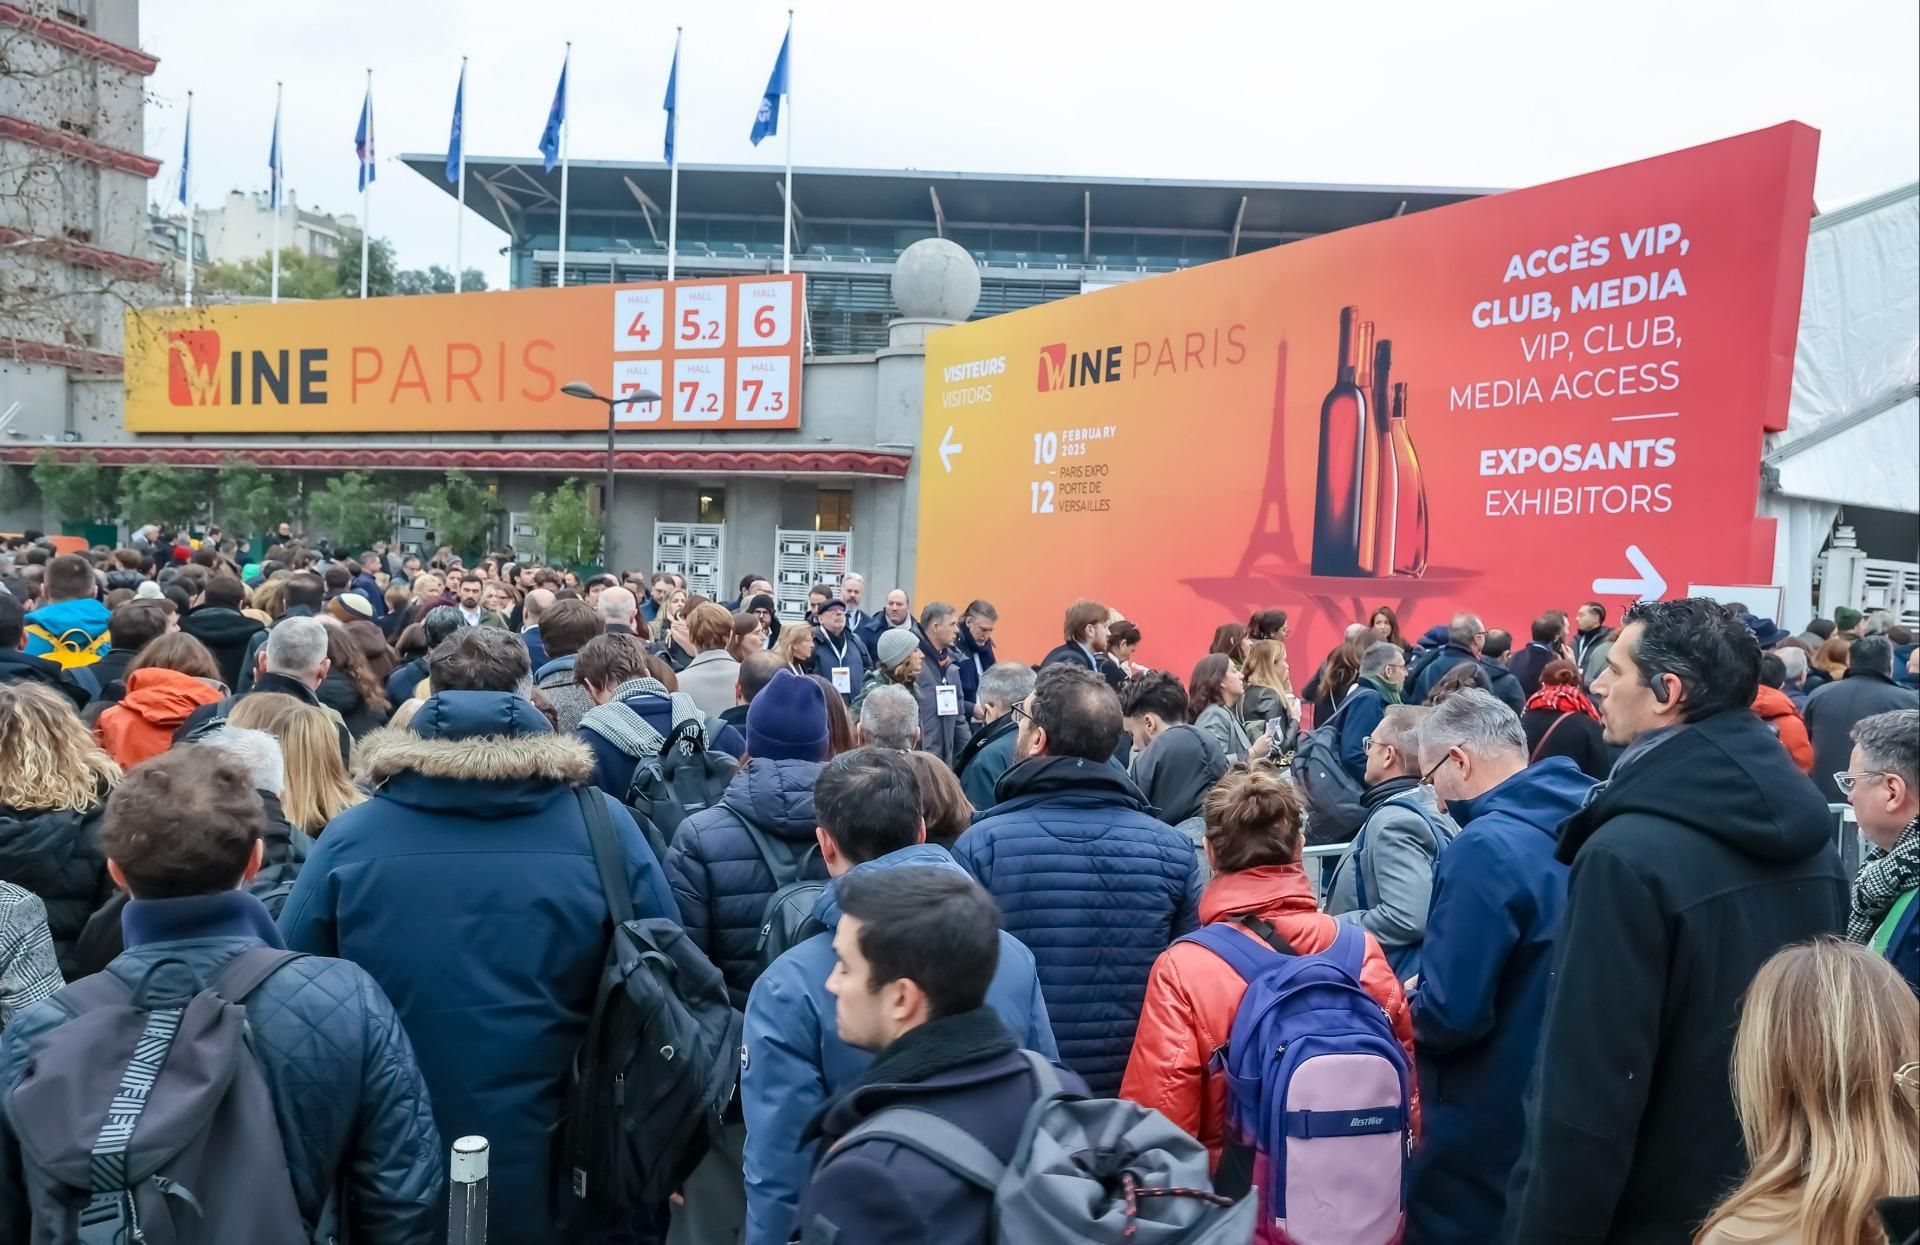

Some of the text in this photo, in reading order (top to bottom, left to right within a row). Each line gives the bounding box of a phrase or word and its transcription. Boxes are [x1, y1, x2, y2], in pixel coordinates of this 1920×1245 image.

[1503, 222, 1690, 283] ACCÈS VIP,
[627, 295, 650, 304] HALL
[689, 292, 712, 302] HALL
[753, 288, 777, 298] HALL
[1472, 268, 1687, 329] CLUB, MEDIA
[627, 312, 650, 342] 4
[681, 309, 720, 341] 5.2
[754, 305, 776, 337] 6
[1133, 323, 1247, 380] PARIS
[1520, 315, 1682, 362] VIP, CLUB,
[351, 339, 557, 404] PARIS
[626, 366, 649, 376] HALL
[688, 364, 711, 374] HALL
[751, 362, 776, 372] HALL
[944, 356, 1007, 383] VISITEURS
[679, 381, 719, 412] 7.2
[742, 379, 783, 411] 7.3
[942, 384, 993, 409] VISITORS
[1450, 361, 1680, 411] MEDIA ACCESS
[1033, 431, 1057, 465] 10
[1062, 425, 1116, 442] FEBRUARY
[1061, 443, 1086, 456] 2025
[1479, 437, 1677, 476] EXPOSANTS
[1060, 464, 1109, 478] PARIS EXPO
[1031, 480, 1055, 513] 12
[1059, 481, 1102, 495] PORTE DE
[1485, 483, 1673, 516] EXHIBITORS
[1059, 499, 1111, 512] VERSAILLES
